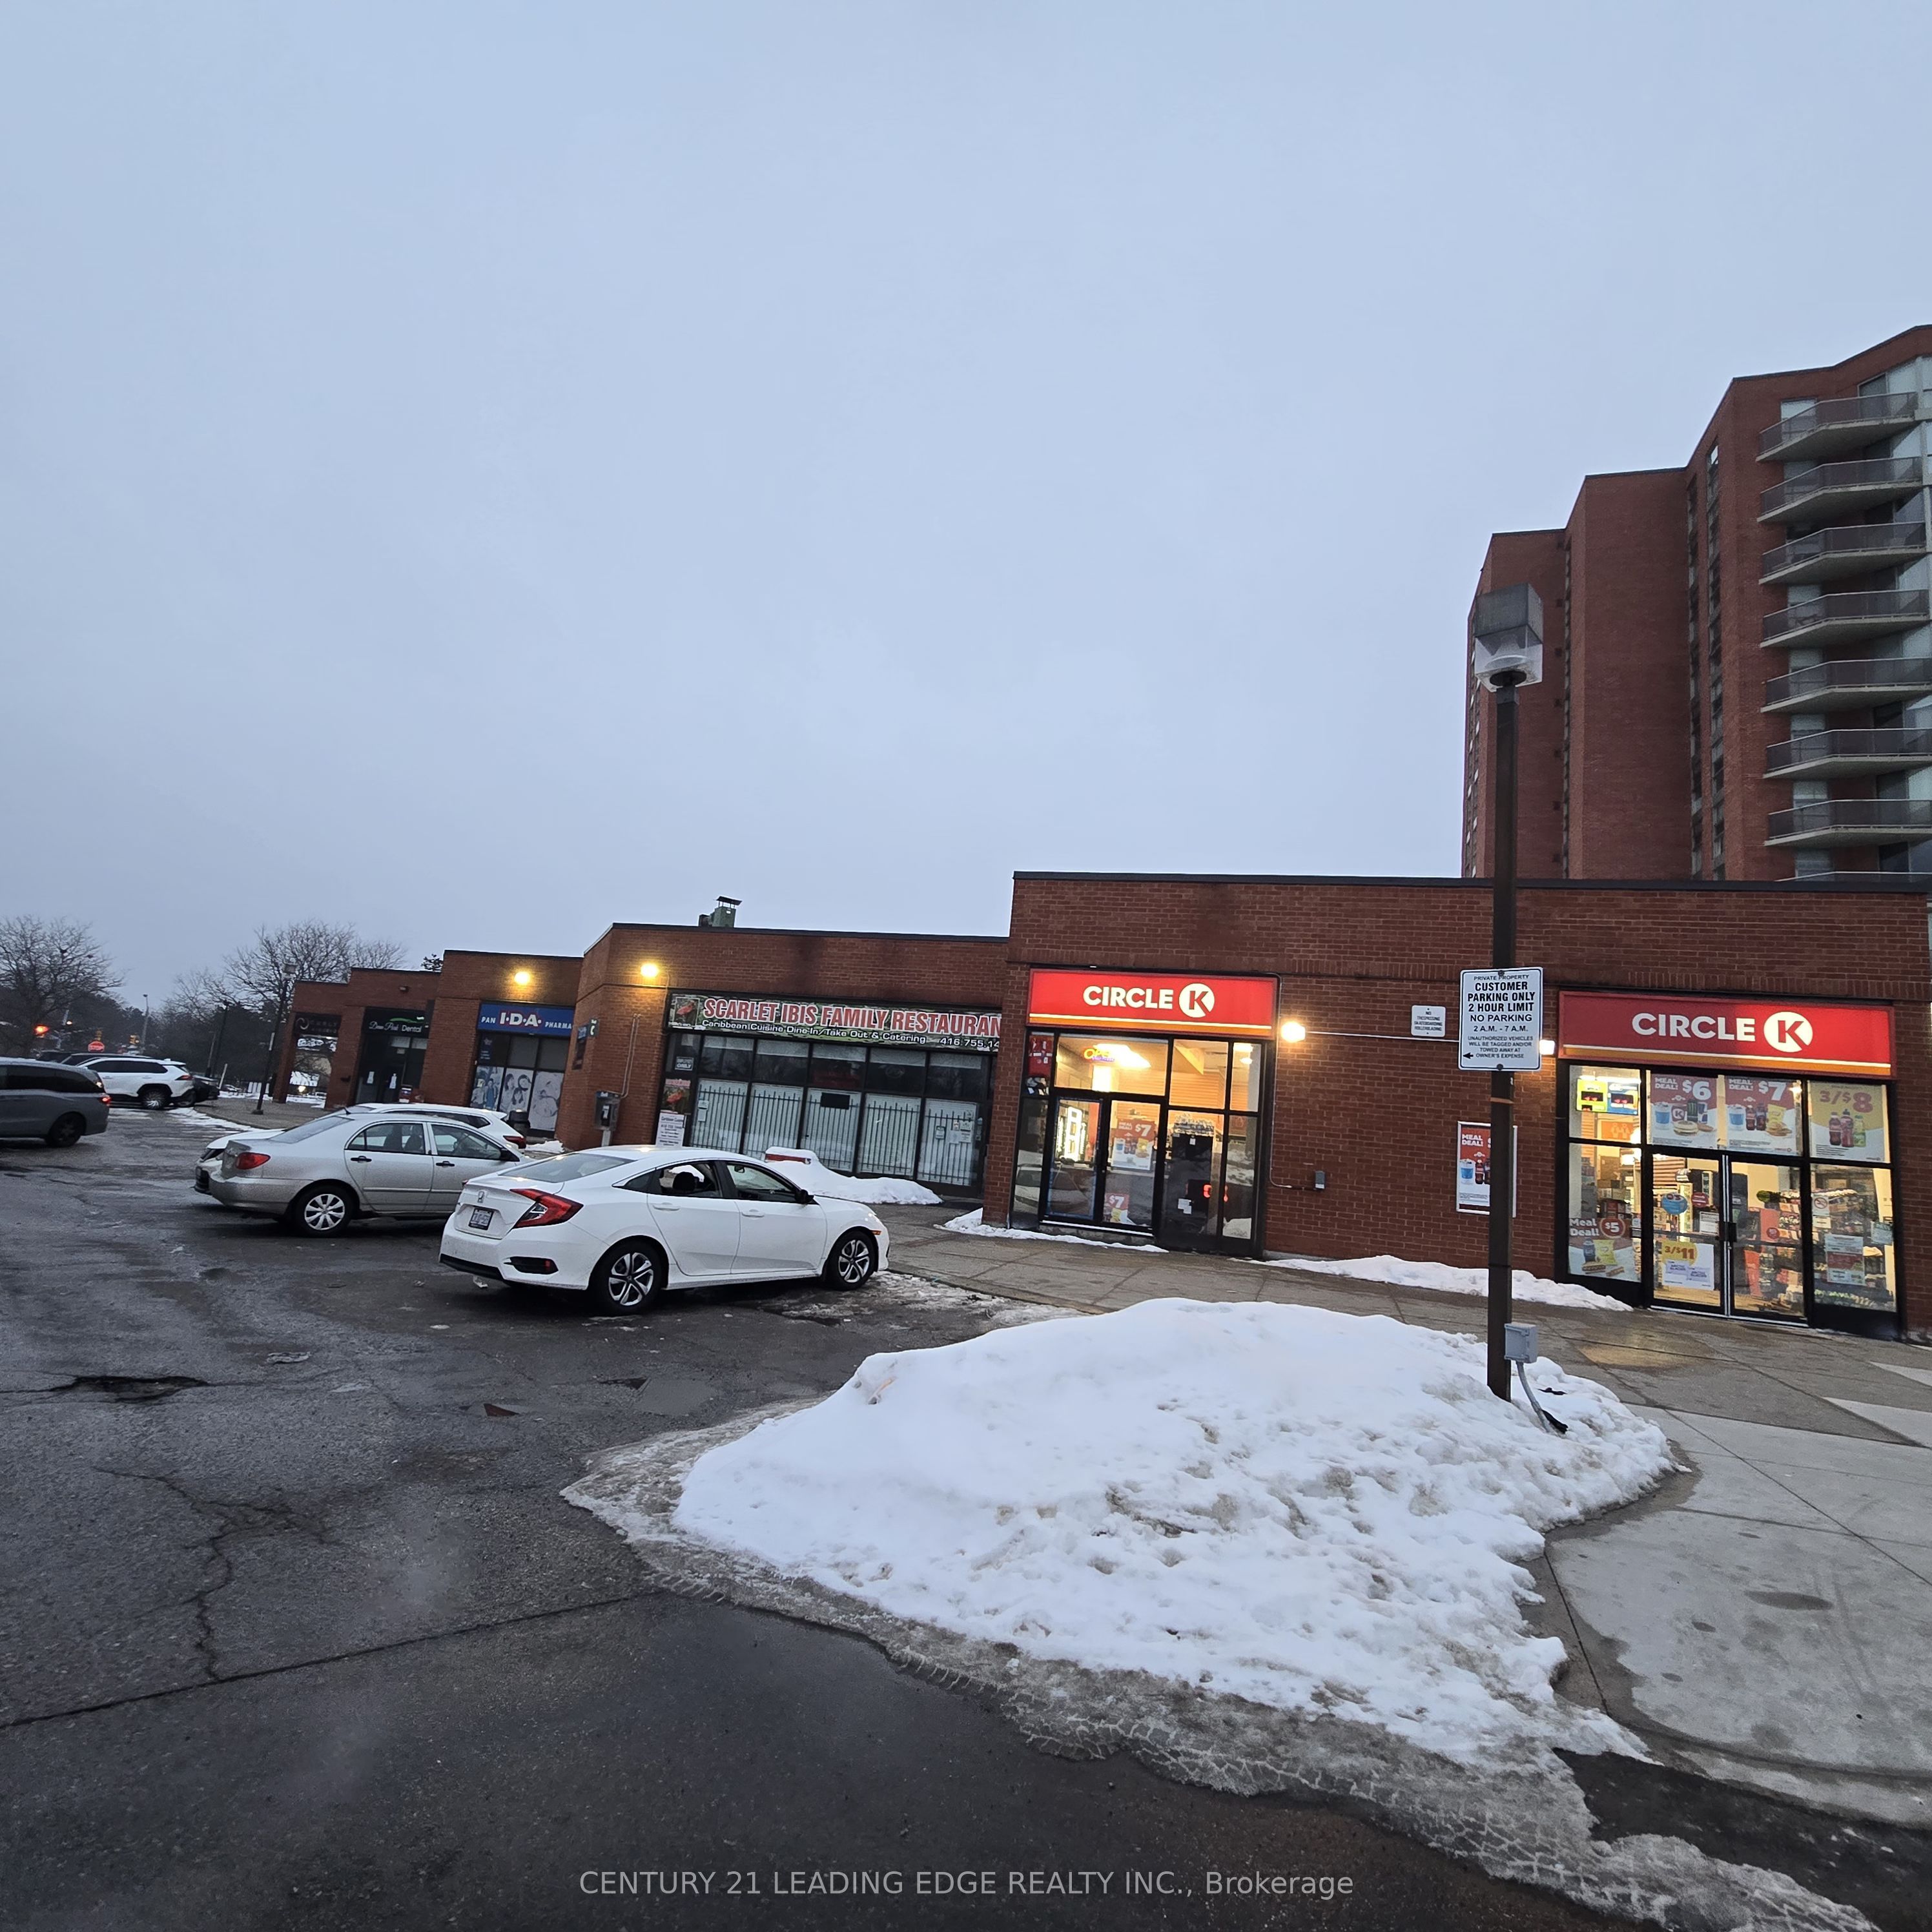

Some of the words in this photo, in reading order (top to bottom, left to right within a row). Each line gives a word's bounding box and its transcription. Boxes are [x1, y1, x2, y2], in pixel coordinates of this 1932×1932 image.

[1475, 981, 1528, 991] CUSTOMER
[1083, 985, 1174, 1009] CIRCLE
[1468, 992, 1508, 1002] PARKING
[1512, 992, 1535, 1001] ONLY
[1468, 1003, 1474, 1012] 2
[1477, 1003, 1504, 1011] HOUR
[1508, 1002, 1534, 1011] LIMIT
[703, 998, 779, 1023] SCARLET
[781, 1003, 818, 1026] IBIS
[821, 1005, 889, 1031] FAMILY
[890, 1011, 1001, 1038] RESTAURAN
[402, 1024, 422, 1033] Dental
[702, 1020, 747, 1030] Caribbean
[750, 1023, 783, 1033] Cuisine
[850, 1031, 868, 1039] Out
[883, 1033, 926, 1044] Catering
[1632, 1012, 1756, 1042] CIRCLE
[1682, 1080, 1711, 1100] $6
[1758, 1080, 1787, 1101] $7
[1820, 1090, 1873, 1113] 3/$8
[1135, 1124, 1152, 1136] $7
[1109, 1195, 1124, 1208] $7
[1569, 1218, 1597, 1226] Meal
[1605, 1222, 1620, 1233] $5
[1665, 1246, 1695, 1260] 3/$11
